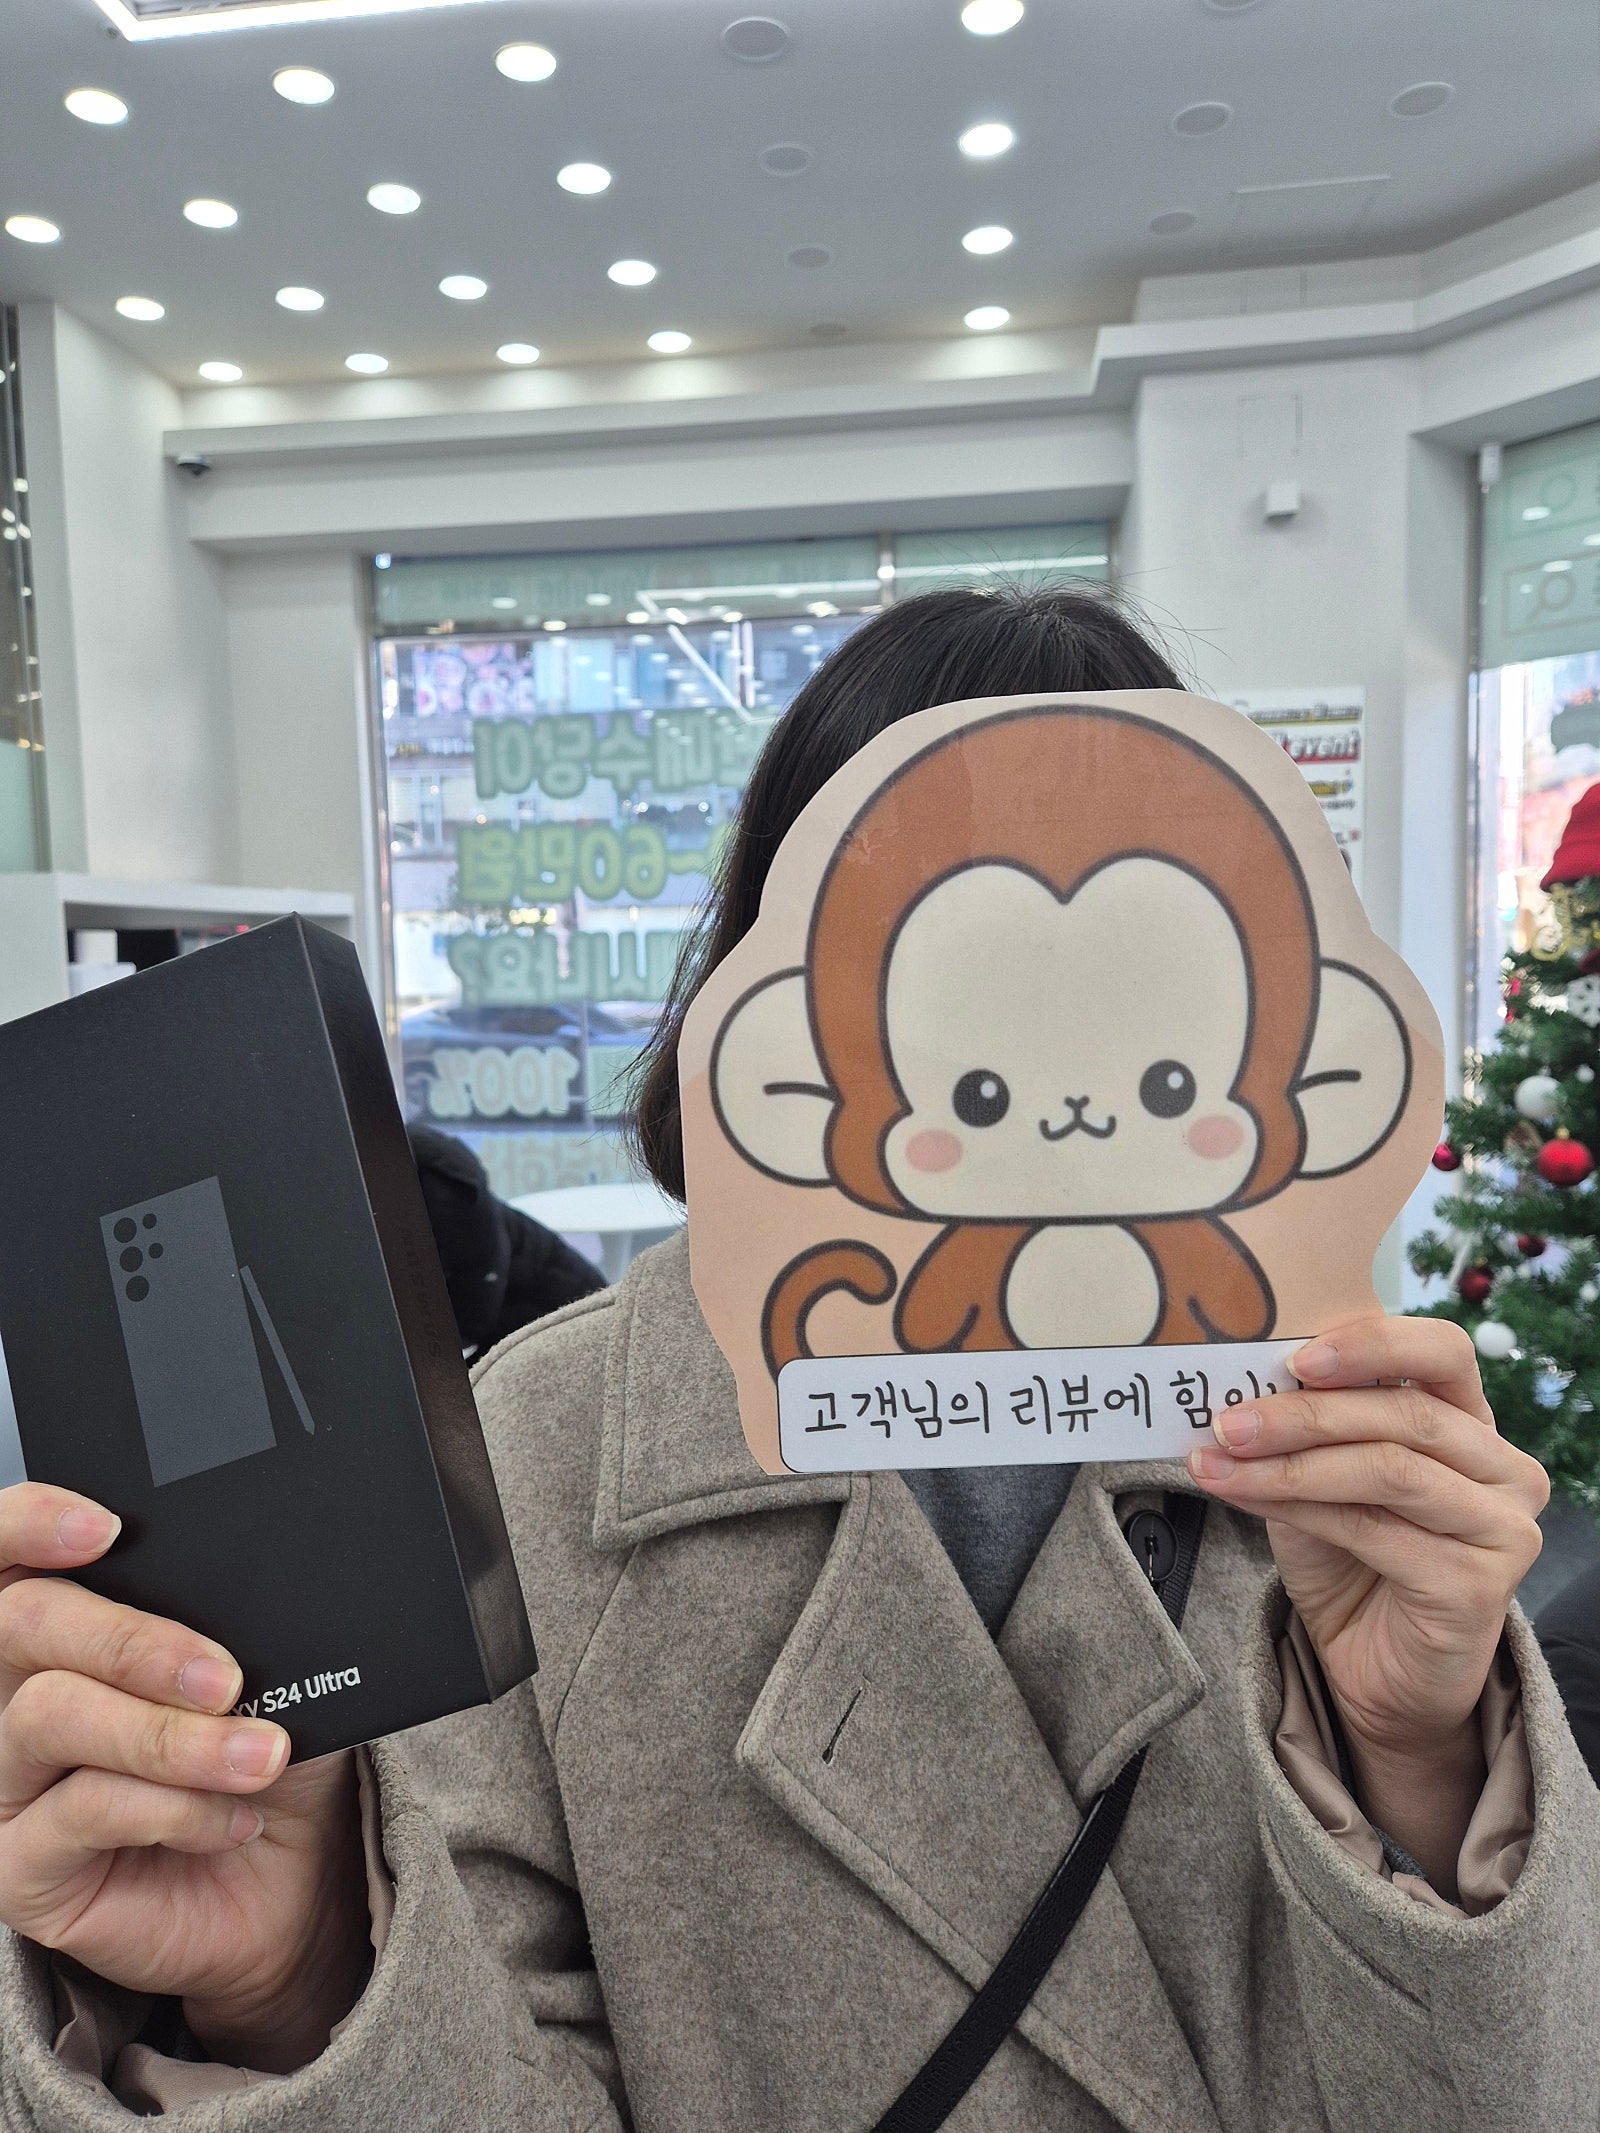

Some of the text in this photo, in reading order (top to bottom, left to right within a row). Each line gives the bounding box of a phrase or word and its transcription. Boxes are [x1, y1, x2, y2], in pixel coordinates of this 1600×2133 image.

[804, 1380, 990, 1439] 고객님의
[1010, 1373, 1151, 1434] 리뷰에
[263, 1683, 302, 1713] S24
[305, 1667, 361, 1698] Ultra
